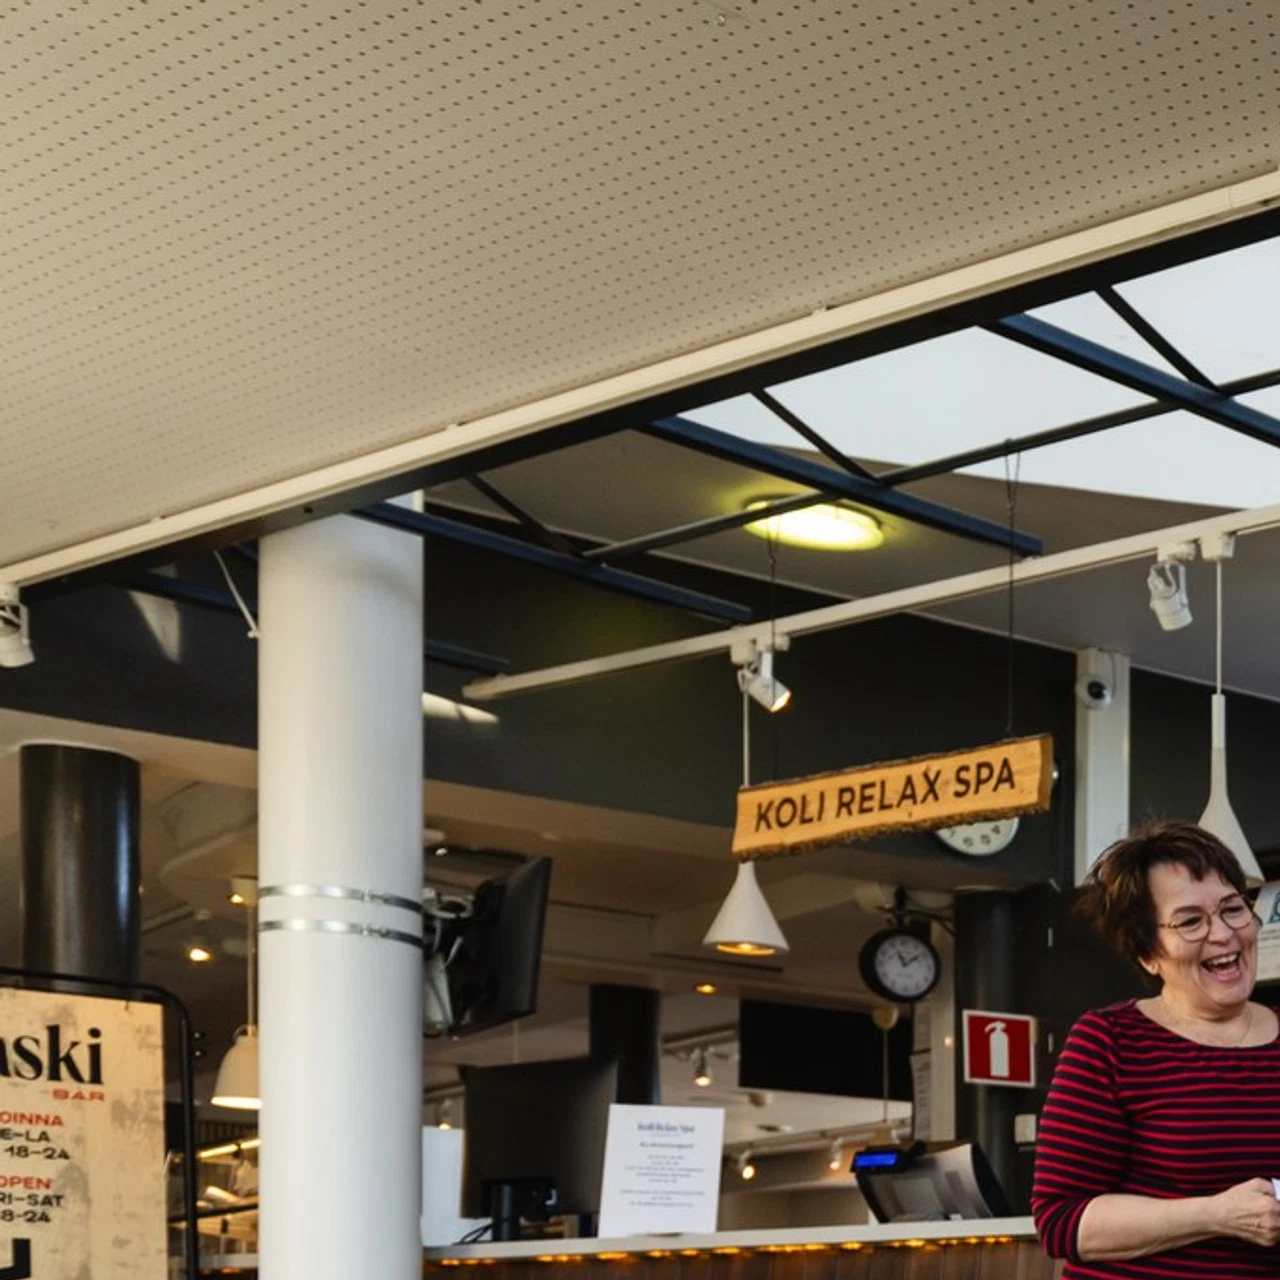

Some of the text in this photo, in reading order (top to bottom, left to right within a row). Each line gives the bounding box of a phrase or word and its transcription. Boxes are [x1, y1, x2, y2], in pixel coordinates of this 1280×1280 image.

[755, 757, 1016, 832] KOLI RELAX SPA
[51, 1088, 105, 1102] BAR
